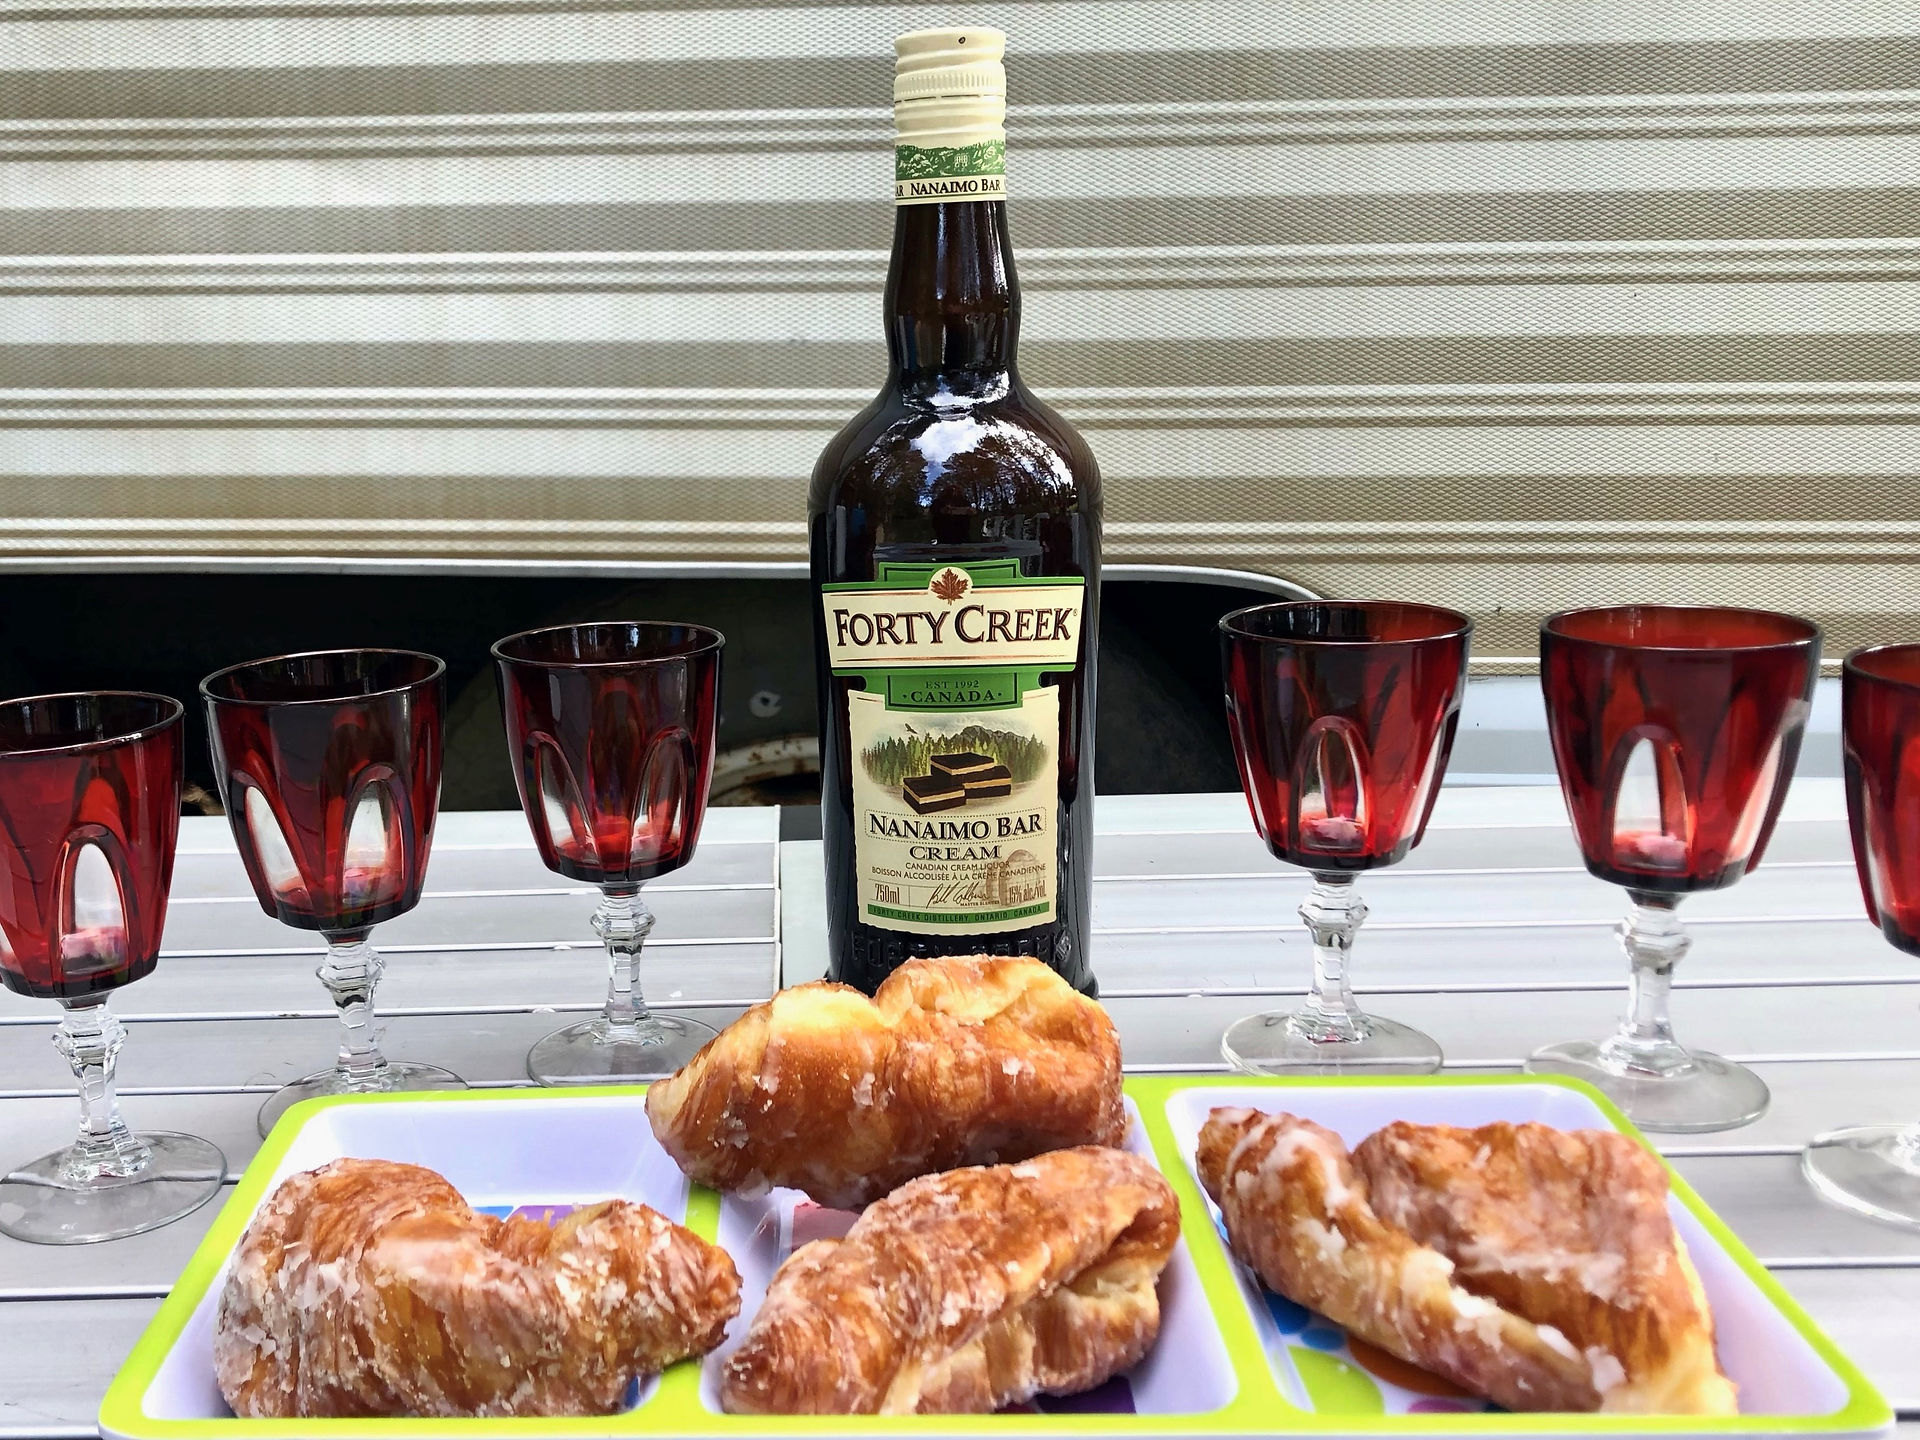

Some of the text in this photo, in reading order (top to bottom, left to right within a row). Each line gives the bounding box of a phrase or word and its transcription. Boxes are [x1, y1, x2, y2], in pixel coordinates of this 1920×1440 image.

[910, 180, 978, 196] NANAIMO
[981, 178, 1001, 192] BAR
[833, 604, 1073, 647] FORTY CREEK
[925, 680, 980, 690] EST 1992
[910, 689, 996, 703] CANADA
[869, 813, 1044, 841] NANAIMO BAR
[909, 845, 1002, 861] CREAM
[871, 866, 902, 877] BOISSON
[903, 871, 950, 881] ALCOOLISÉE
[999, 863, 1046, 878] CANADIENNE
[905, 860, 1011, 871] CANADIAN CREAM LIQUOR
[874, 883, 900, 904] 750ml
[873, 907, 895, 916] FORTY
[897, 912, 921, 920] CREEK
[974, 912, 1008, 921] ONTARIO
[1013, 905, 1042, 917] CANADA
